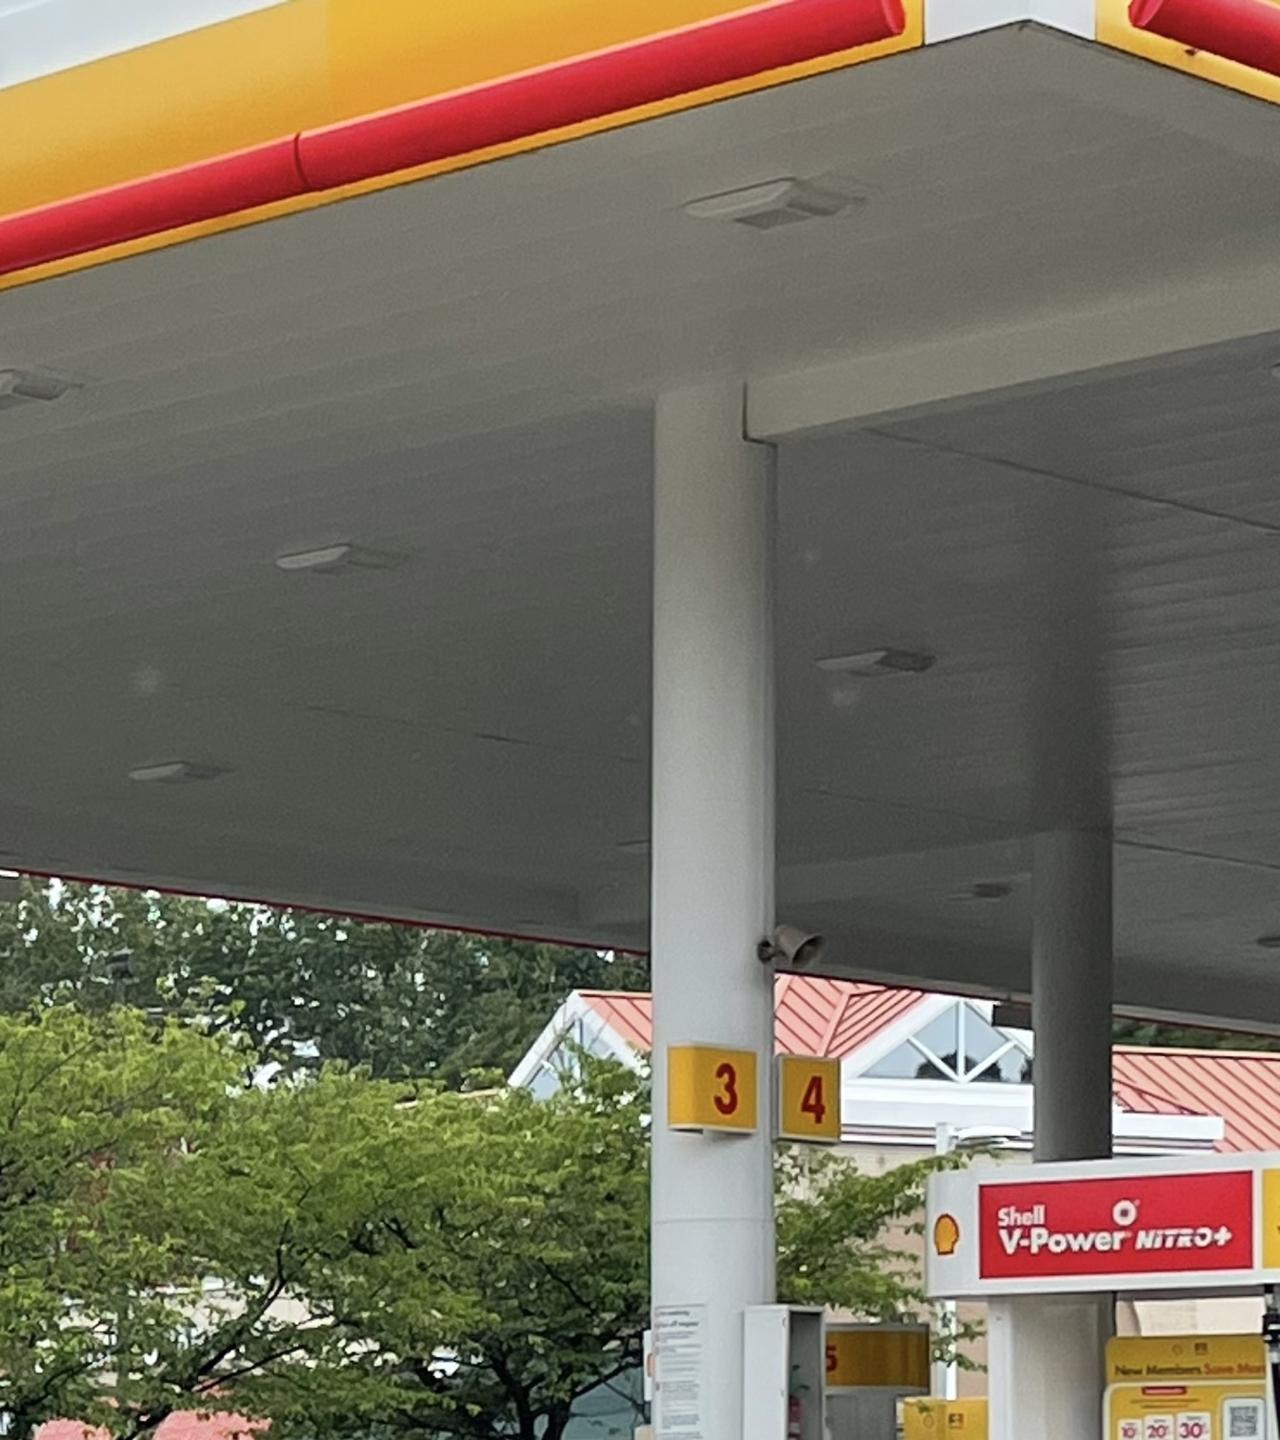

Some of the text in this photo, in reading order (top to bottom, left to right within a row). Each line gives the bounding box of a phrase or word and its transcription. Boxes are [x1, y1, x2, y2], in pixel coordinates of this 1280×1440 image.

[713, 1062, 738, 1115] 3
[800, 1075, 825, 1124] 4
[997, 1205, 1045, 1226] Shell
[998, 1225, 1232, 1255] V-Power NITRO+
[825, 1346, 838, 1372] 5
